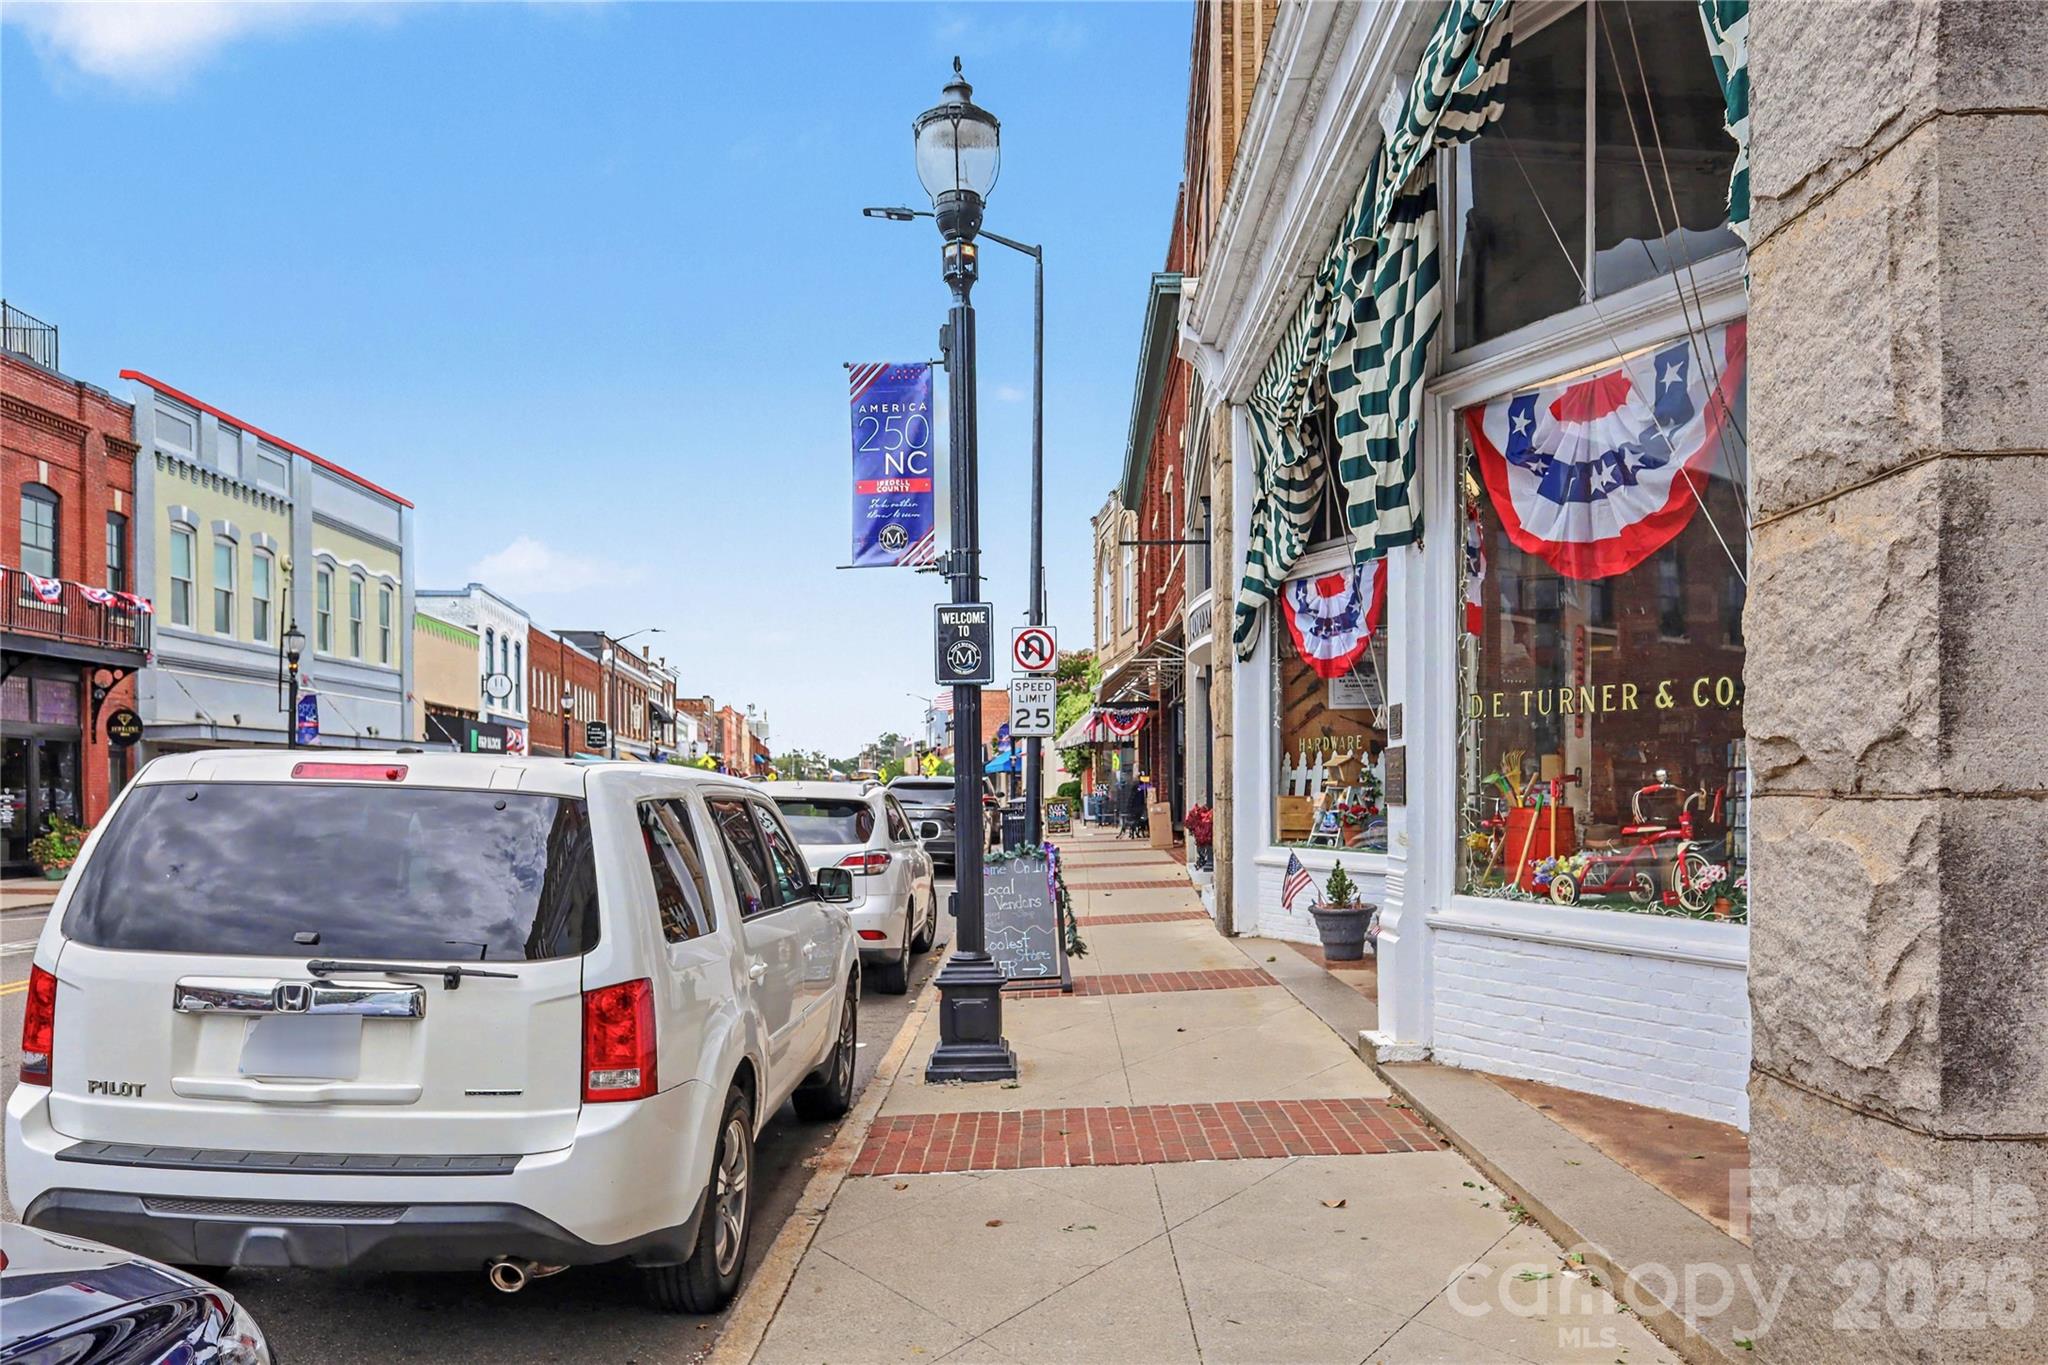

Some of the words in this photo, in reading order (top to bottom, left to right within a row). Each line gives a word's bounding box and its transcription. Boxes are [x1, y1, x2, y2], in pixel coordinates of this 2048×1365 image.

[859, 402, 927, 413] AMERICA
[859, 414, 929, 452] 250
[884, 451, 928, 475] NC
[876, 485, 909, 493] COUNTY
[886, 532, 901, 544] M
[941, 611, 986, 624] WELCOME
[958, 625, 970, 637] TO
[956, 650, 973, 664] M
[1015, 682, 1052, 691] SPEED
[1018, 694, 1047, 703] LIMIT
[1469, 692, 1511, 719] D.E.
[1520, 682, 1639, 716] TURNER
[1655, 680, 1675, 709] &
[1692, 676, 1740, 708] CO.
[1015, 708, 1051, 728] 25
[1298, 734, 1363, 752] HARDWARE
[1013, 858, 1030, 874] On
[1032, 858, 1047, 873] In
[993, 894, 1042, 911] Vendors
[984, 931, 1031, 953] oolest
[1014, 947, 1052, 962] Store
[87, 1079, 147, 1098] PILOT
